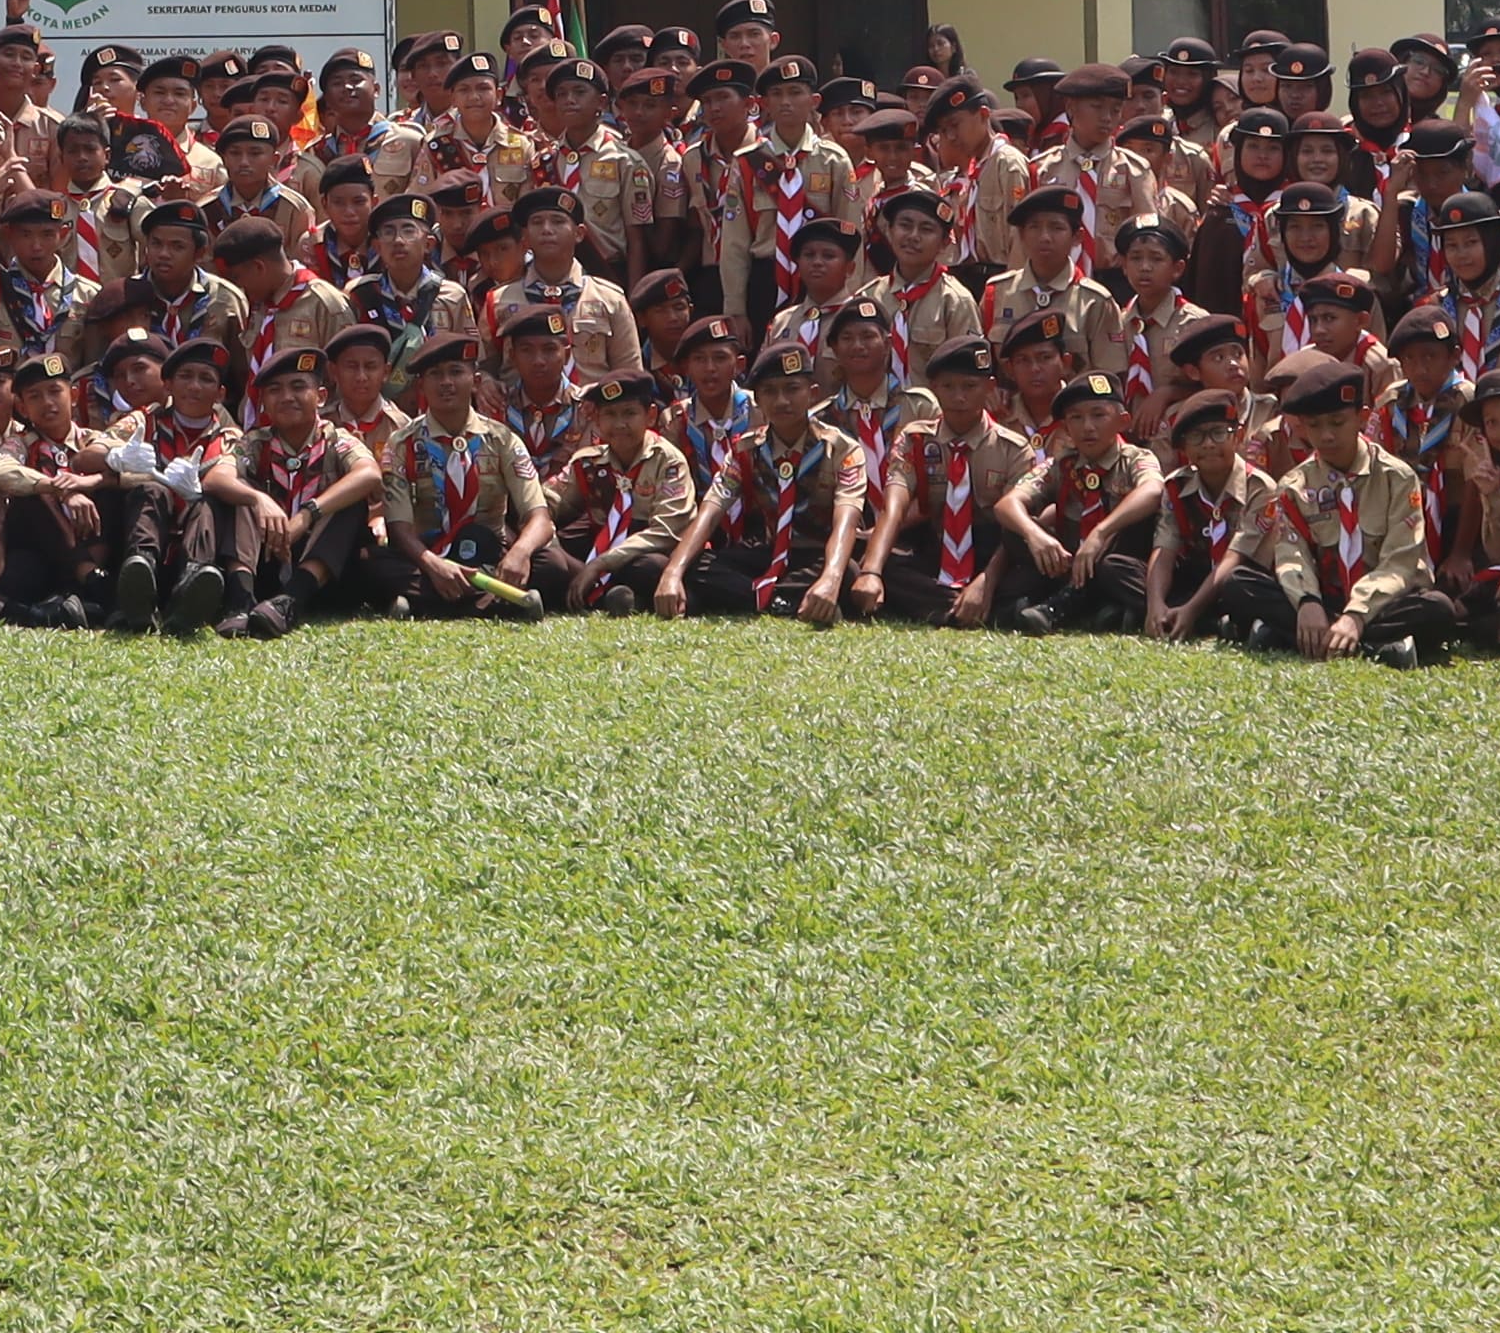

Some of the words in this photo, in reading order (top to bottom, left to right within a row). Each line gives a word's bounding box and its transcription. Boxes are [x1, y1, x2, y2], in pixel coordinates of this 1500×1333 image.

[62, 4, 110, 30] MEDAN
[147, 5, 212, 14] SEKRETARIAT
[215, 5, 268, 13] PENGURUS
[271, 5, 297, 13] KOTA
[300, 4, 337, 12] MEDAN
